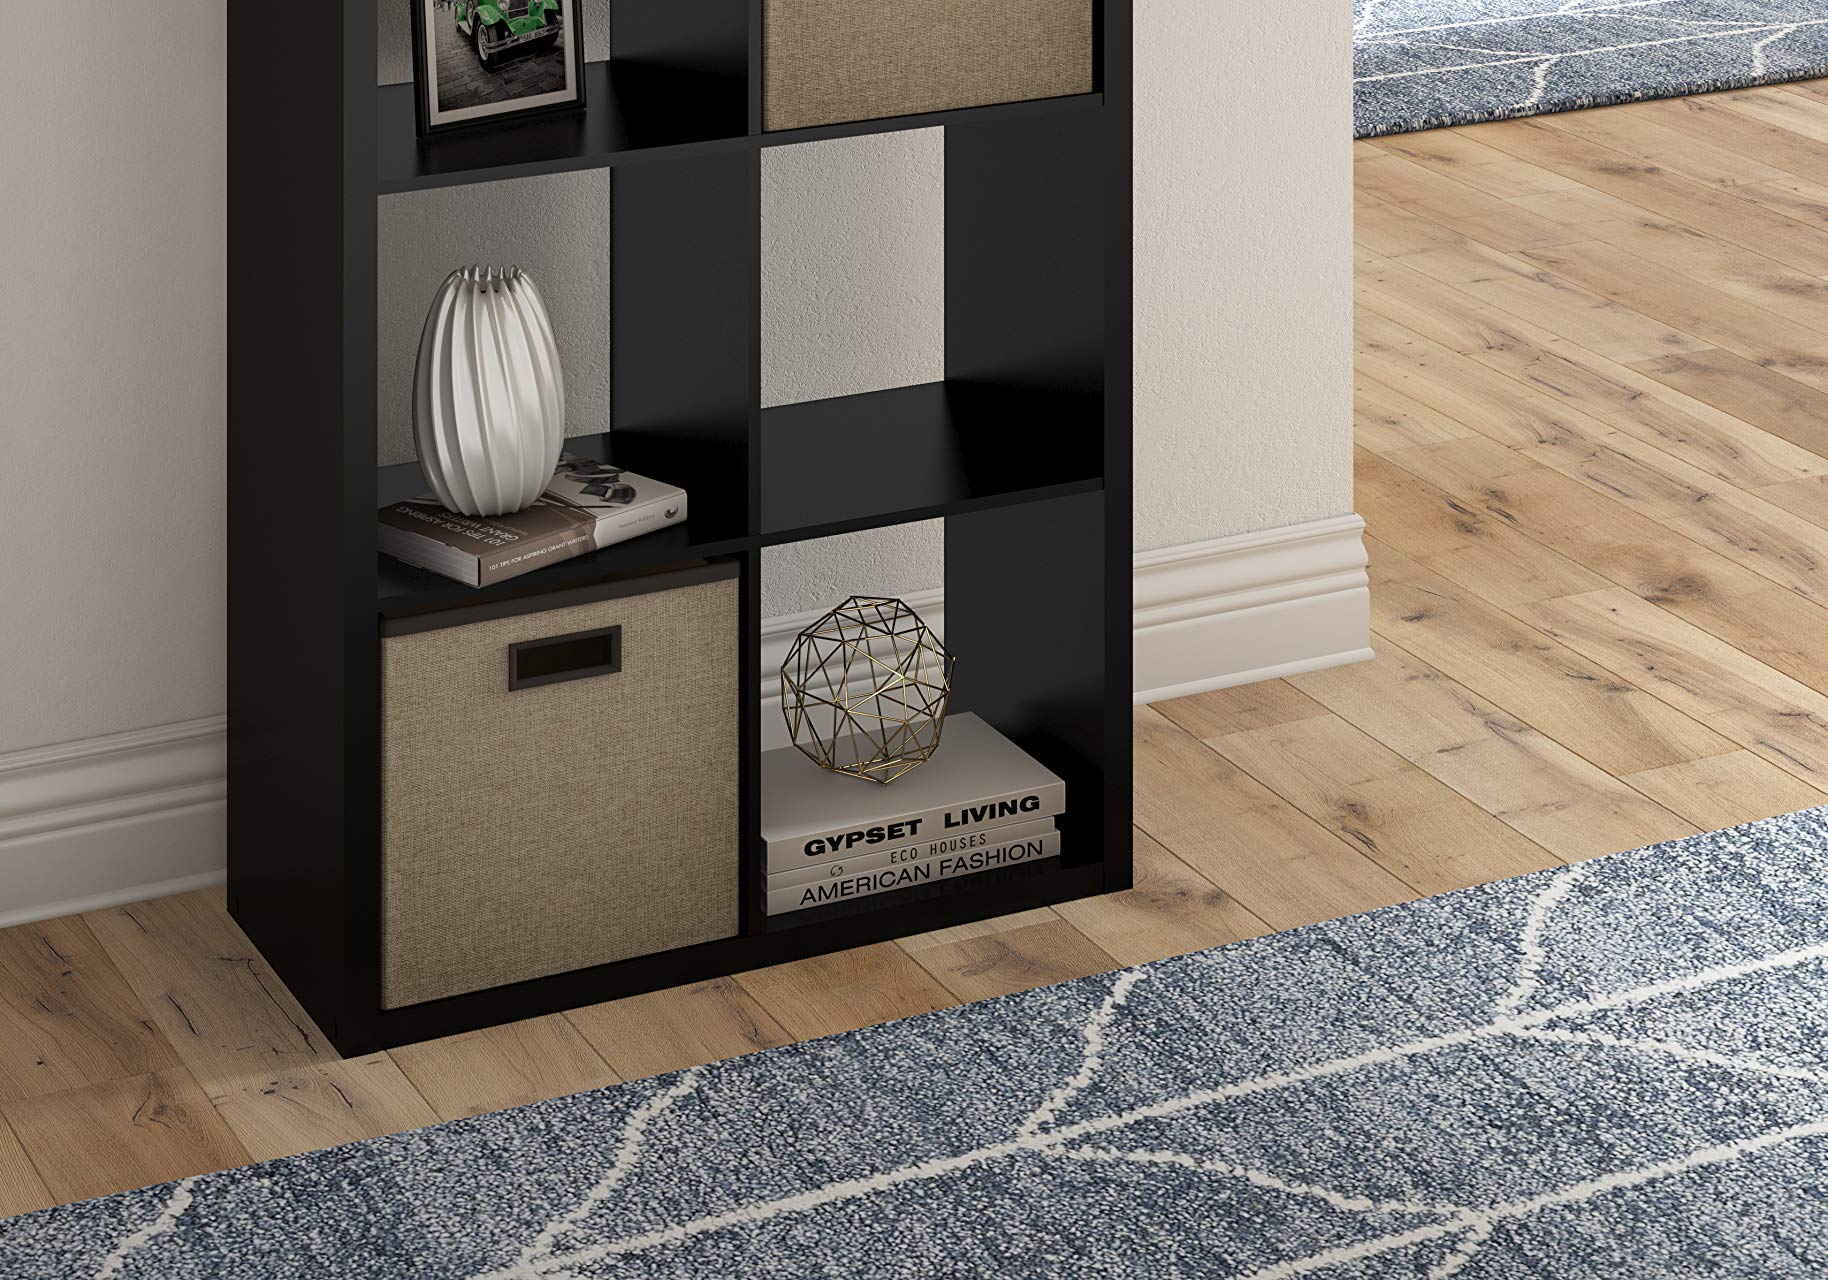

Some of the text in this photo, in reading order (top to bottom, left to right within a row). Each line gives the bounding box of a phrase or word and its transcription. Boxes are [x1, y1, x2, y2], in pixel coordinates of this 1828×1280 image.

[442, 522, 467, 533] FOR
[462, 530, 487, 540] TIPS
[478, 526, 520, 541] GRANT
[483, 536, 506, 547] 101
[489, 534, 590, 571] 101 TIPS FOR ASPIRING GRANT WRITERS
[803, 795, 1040, 857] GYPSET LIVING
[890, 832, 987, 864] ECO HOUSES
[799, 839, 1044, 906] AMERICAN FASHION
